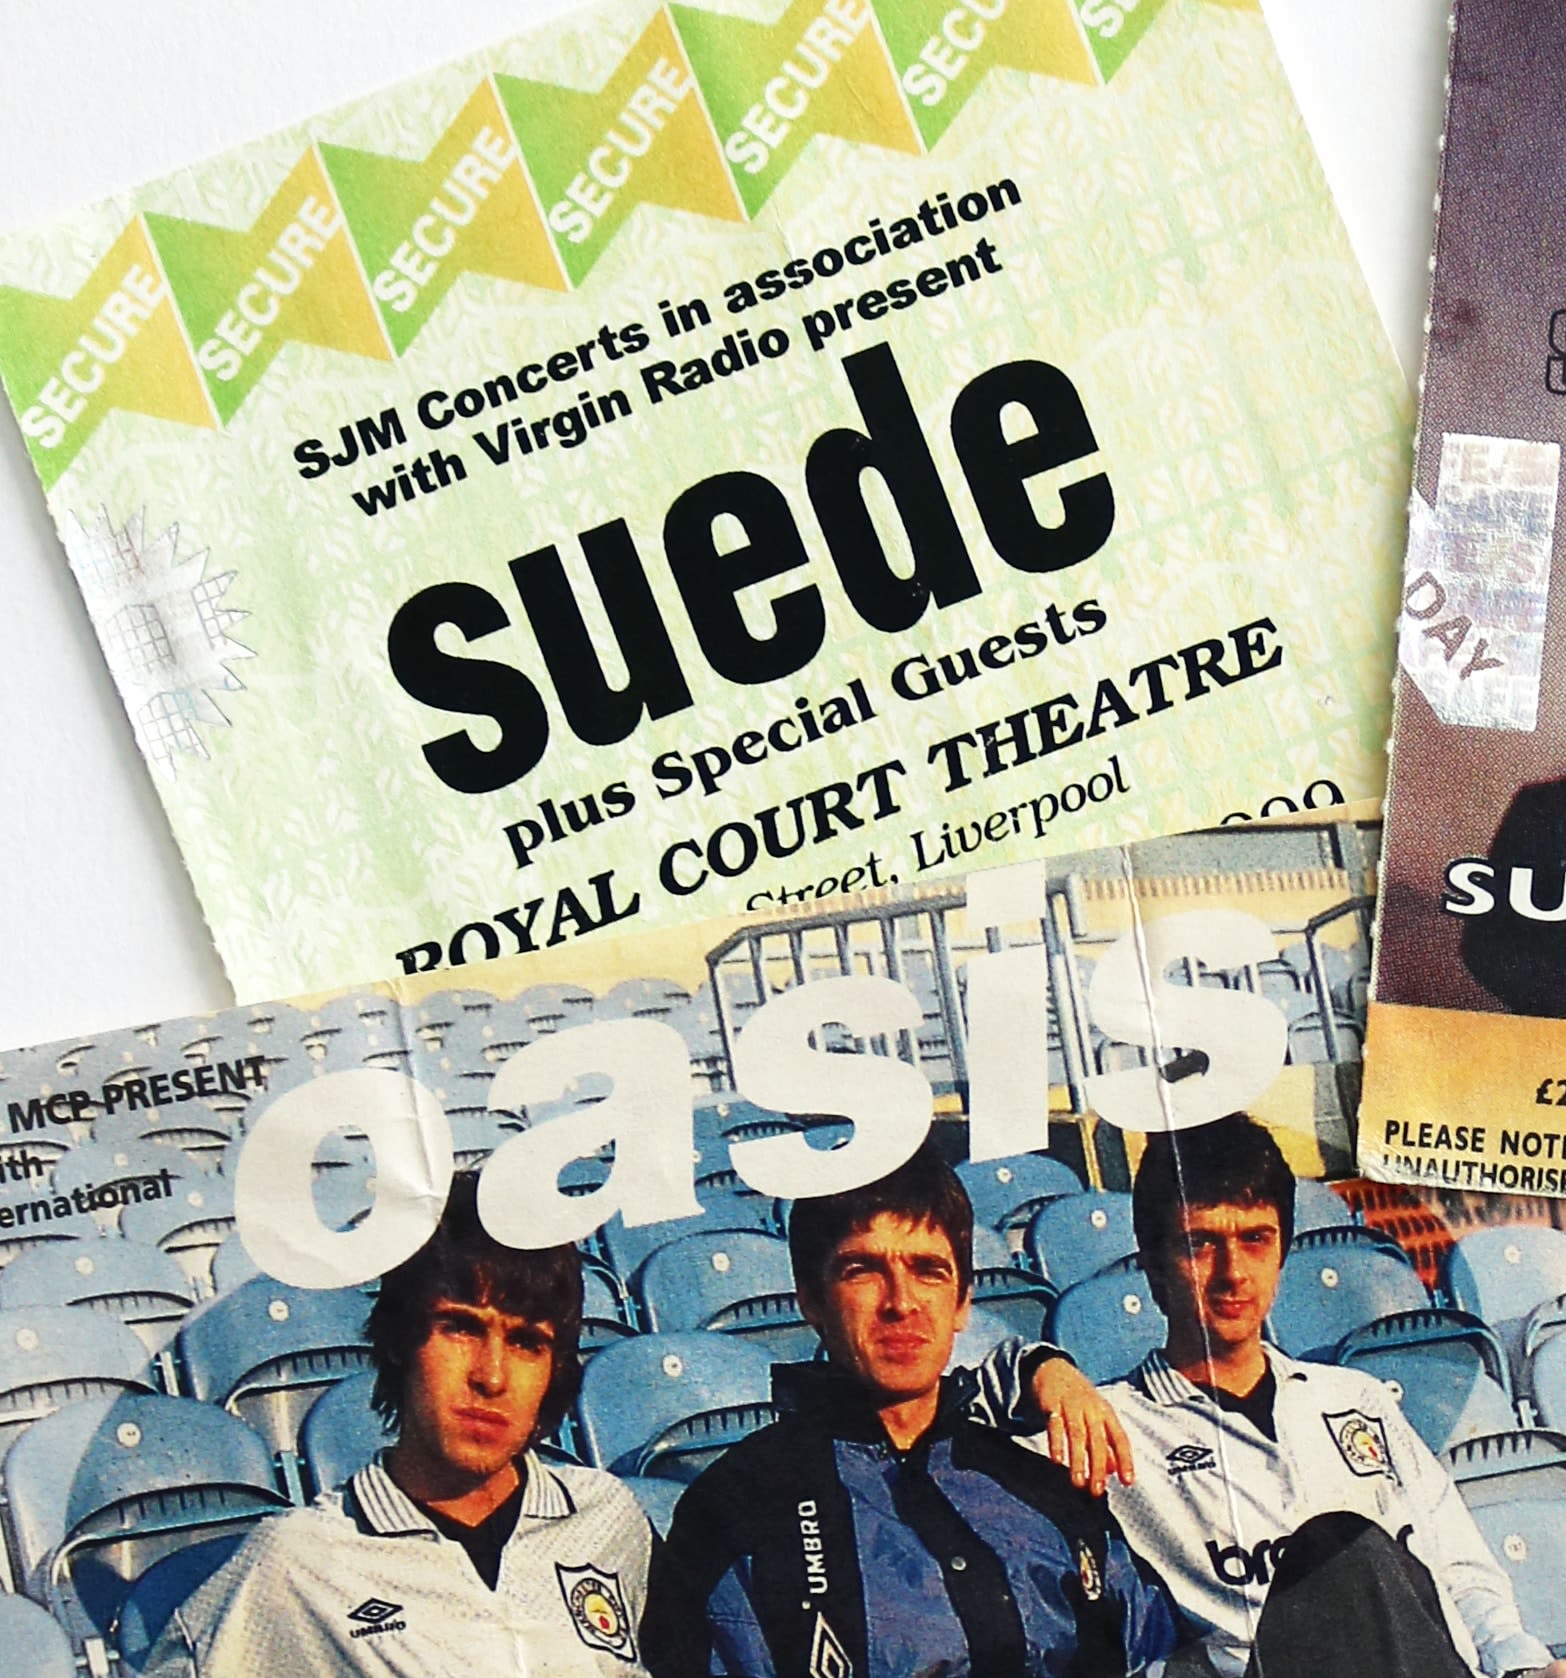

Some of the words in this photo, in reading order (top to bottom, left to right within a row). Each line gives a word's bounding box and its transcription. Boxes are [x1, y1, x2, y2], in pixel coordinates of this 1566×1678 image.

[293, 409, 407, 479] SJM
[417, 323, 650, 429] Concerts
[658, 300, 712, 337] in
[723, 178, 1021, 313] association
[373, 126, 517, 312] SECURE
[23, 262, 166, 448] SECURE
[352, 449, 467, 516] with
[474, 391, 632, 465] Virgin
[640, 331, 790, 404] Radio
[802, 238, 1002, 350] present
[388, 342, 1114, 794] suede
[504, 781, 636, 868] plus
[651, 679, 878, 798] Special
[891, 599, 1108, 701] Guests
[659, 765, 913, 895] COURT
[928, 617, 1284, 791] THEATRE
[911, 756, 1130, 872] Liverpool
[8, 1090, 90, 1134] MCP
[102, 1056, 265, 1114] PRESENT
[235, 857, 1287, 1291] oasis
[1385, 1119, 1486, 1152] PLEASE
[798, 1500, 828, 1593] UMBRO
